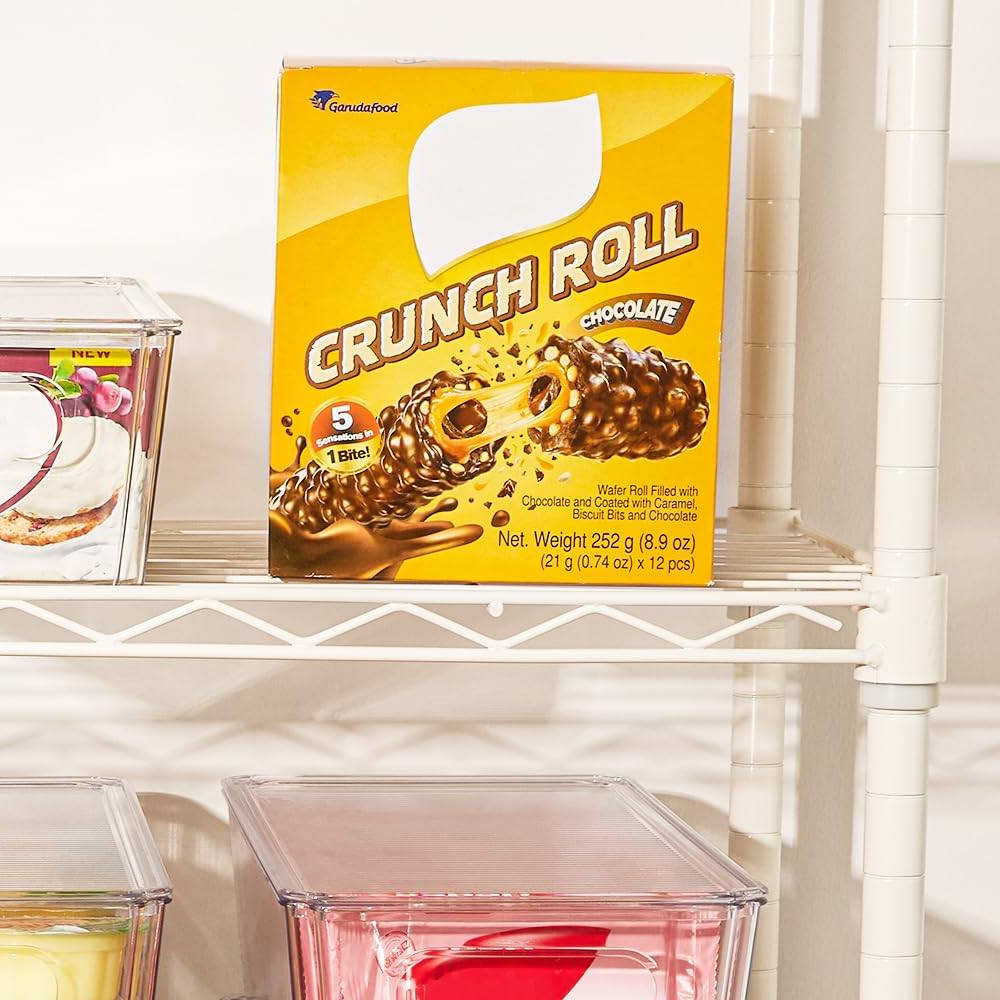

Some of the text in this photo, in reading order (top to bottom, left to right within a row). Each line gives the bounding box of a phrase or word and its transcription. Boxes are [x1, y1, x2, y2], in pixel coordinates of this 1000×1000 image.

[329, 102, 398, 113] Garudafood
[307, 203, 698, 387] CRUNCH ROLL
[579, 299, 681, 330] CHOCOLATE
[71, 350, 111, 358] NEW
[331, 405, 353, 431] 5
[327, 446, 370, 464] 1 Bite!
[597, 484, 699, 496] Wafer Roll Filled with
[521, 495, 698, 510] Chocolate and Coated with Caramel,
[572, 508, 698, 522] Biscuit Bits and Chocolate
[498, 530, 696, 554] Net. Weight 252 g (8.9 oz)
[540, 554, 696, 574] (21 g (0.74 oz) x 12 pcs)
